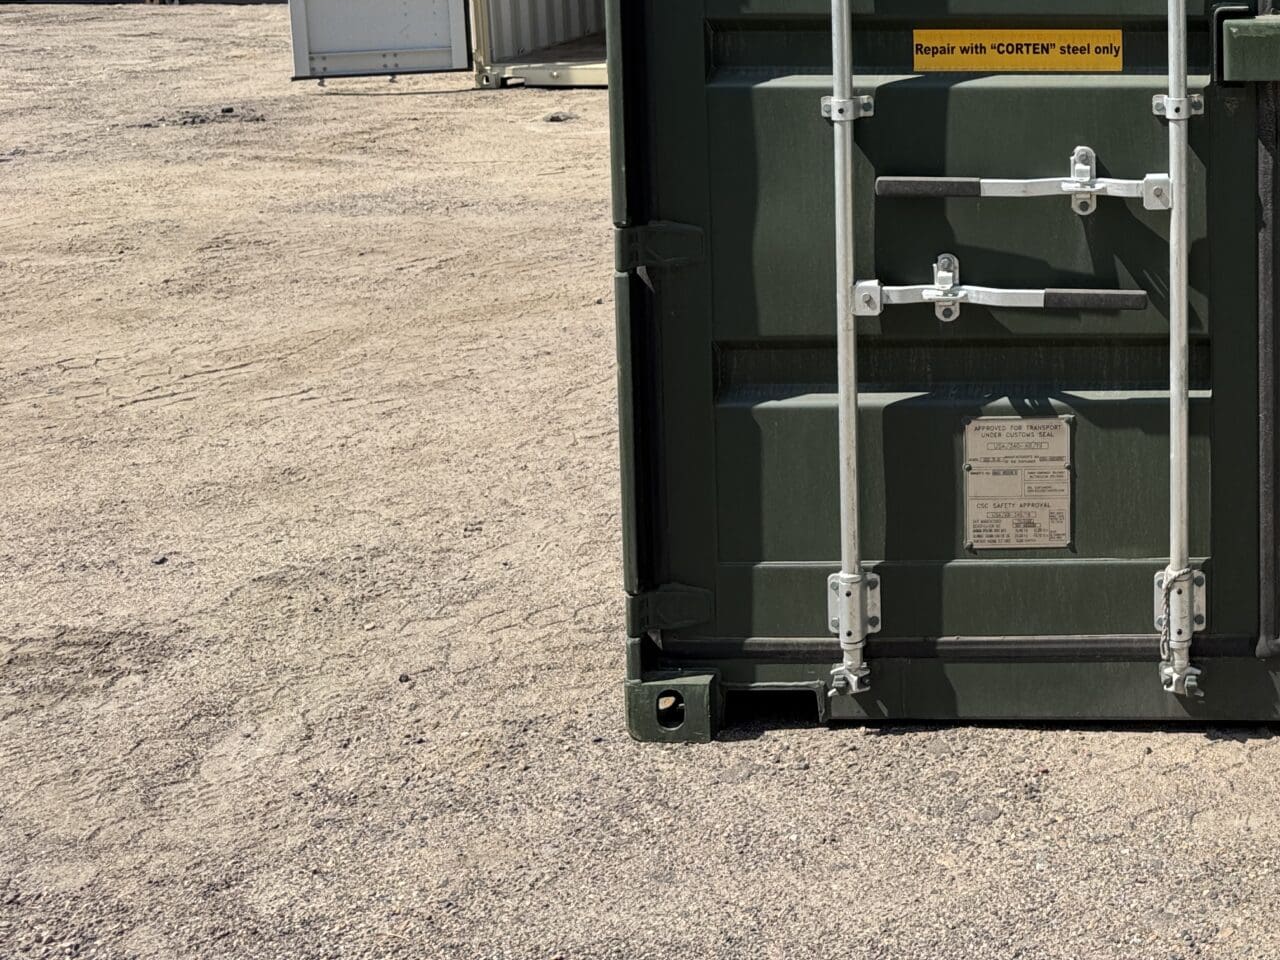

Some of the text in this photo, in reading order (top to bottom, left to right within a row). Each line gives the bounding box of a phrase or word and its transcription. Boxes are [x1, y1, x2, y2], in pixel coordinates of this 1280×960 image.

[915, 43, 956, 57] Repair
[959, 43, 987, 55] with
[1059, 43, 1091, 55] steel
[1094, 43, 1121, 57] only
